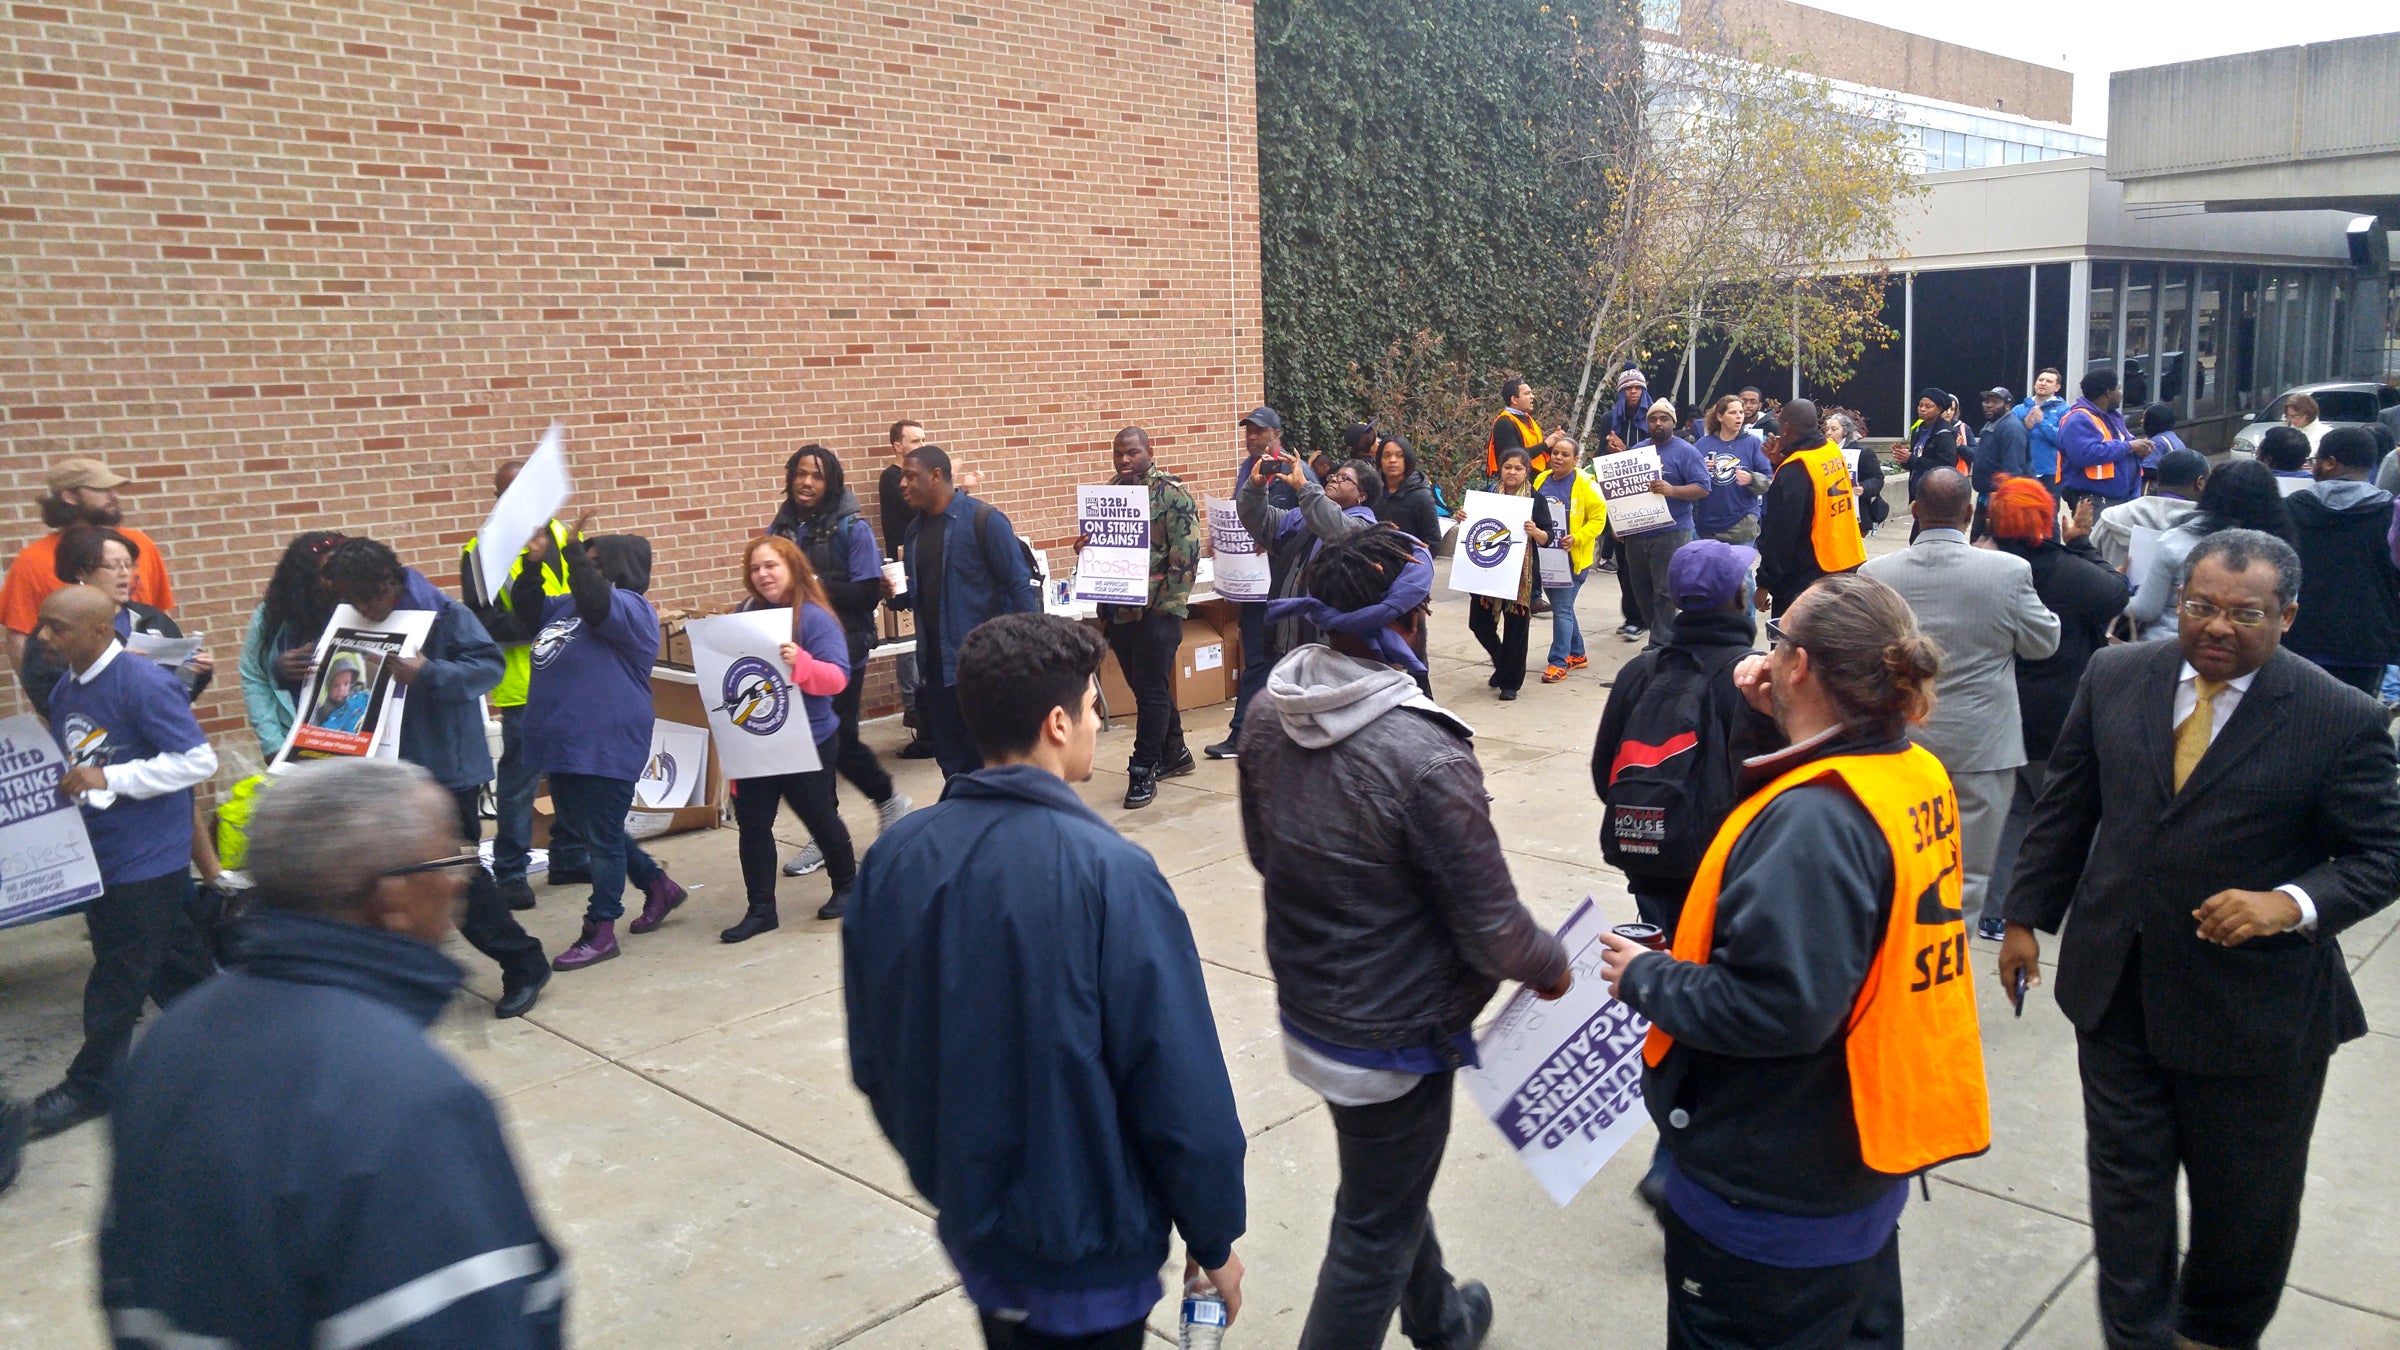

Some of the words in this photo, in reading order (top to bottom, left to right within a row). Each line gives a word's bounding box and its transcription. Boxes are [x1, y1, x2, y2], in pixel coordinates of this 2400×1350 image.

[1614, 458, 1638, 469] 32BJ
[1615, 463, 1651, 477] UNITED
[1604, 480, 1620, 490] ON
[1623, 472, 1656, 487] STRIKE
[1100, 497, 1127, 507] 32BJ
[1100, 508, 1140, 518] UNITED
[1085, 521, 1104, 532] ON
[1107, 522, 1144, 533] STRIKE
[1217, 519, 1243, 528] UNITE
[1089, 533, 1140, 546] AGAINST
[1221, 531, 1254, 541] STRIK
[0, 749, 44, 775] ITED
[1615, 815, 1664, 831] HOUSE
[1619, 844, 1660, 855] WINNER
[1606, 1012, 1652, 1056] ON
[1514, 1002, 1629, 1114] AGAINST
[1514, 1050, 1607, 1138] STRIKE
[1541, 1064, 1638, 1149] UNITED
[1581, 1079, 1643, 1142] 32BJ
